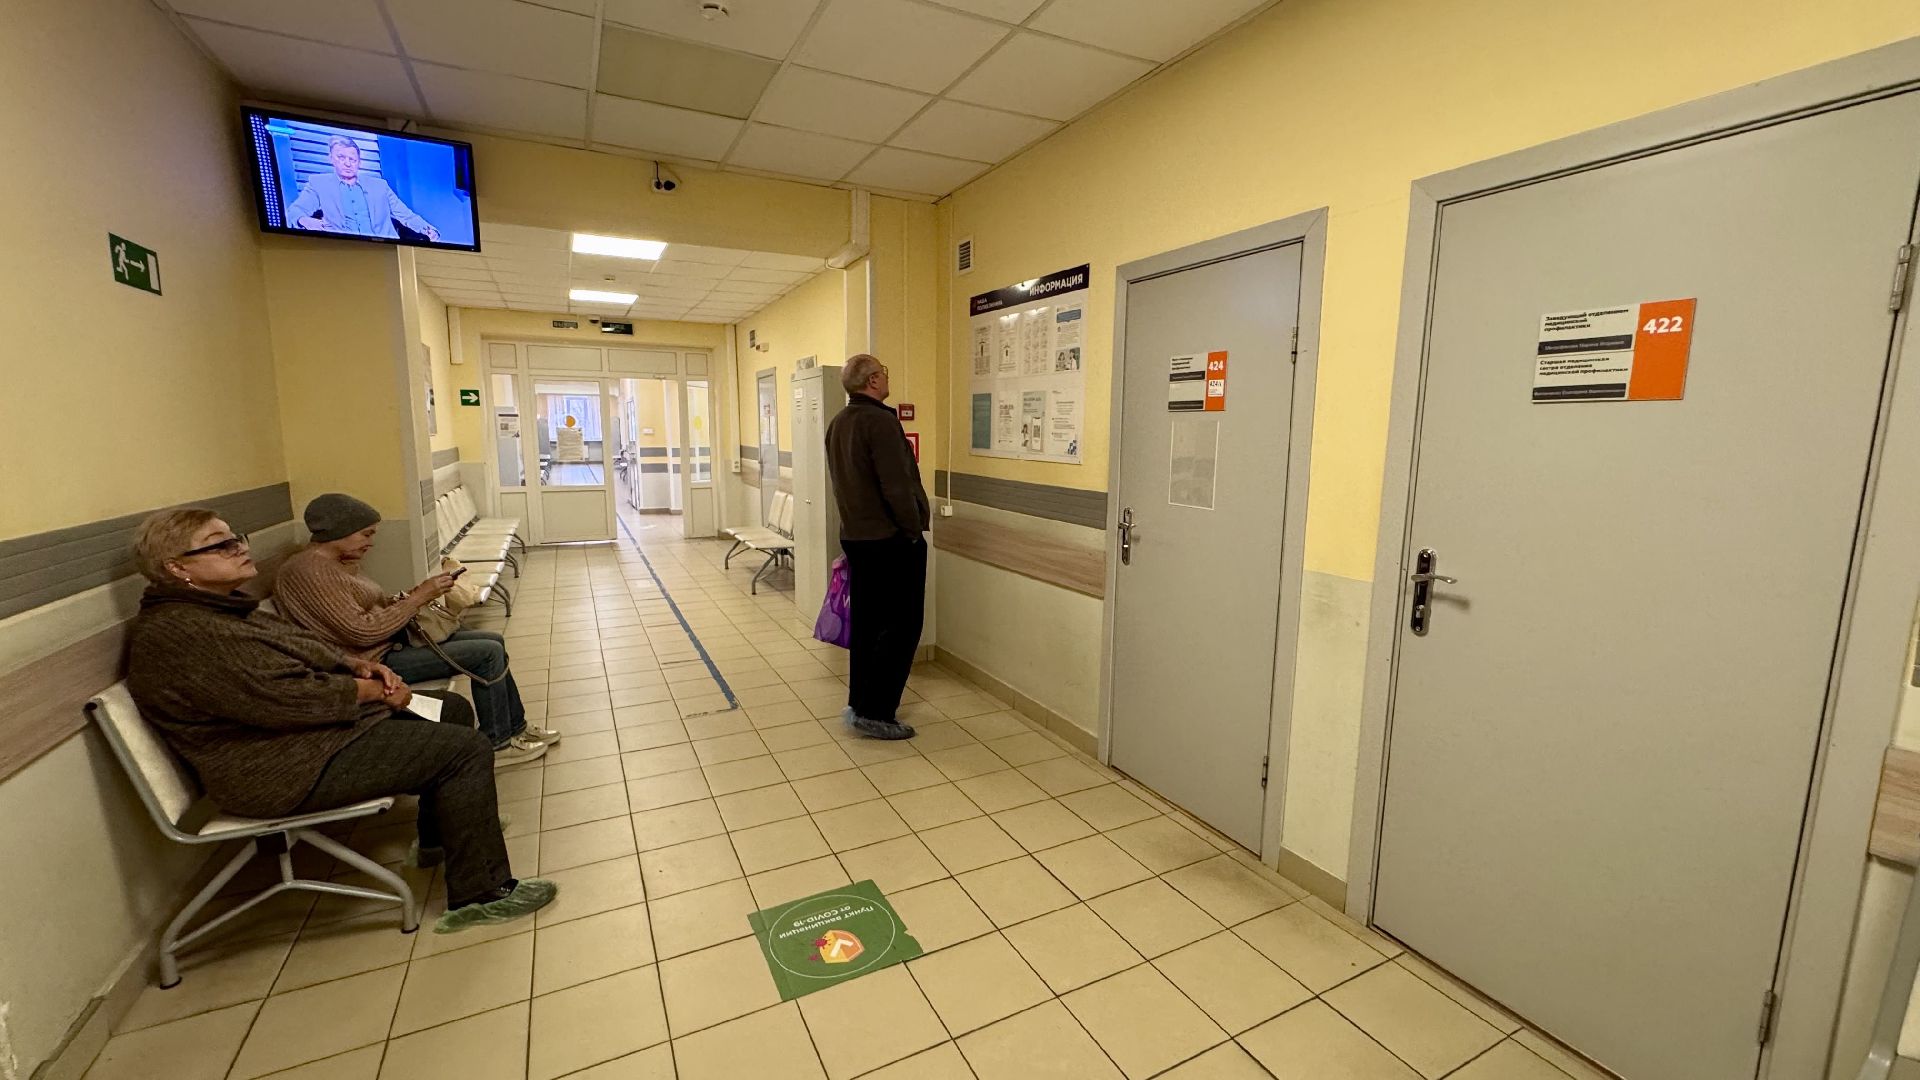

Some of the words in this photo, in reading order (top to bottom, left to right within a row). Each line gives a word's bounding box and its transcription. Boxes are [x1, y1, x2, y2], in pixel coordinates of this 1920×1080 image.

[1029, 273, 1083, 297] ИНФОРМАЦИЯ
[1546, 312, 1587, 321] Заведующий
[1643, 315, 1683, 334] 422
[1208, 360, 1224, 371] 424
[1579, 367, 1629, 375] профилактики
[793, 909, 839, 927] COVID-19
[844, 905, 874, 919] Пункт
[779, 915, 842, 939] вакцинации
